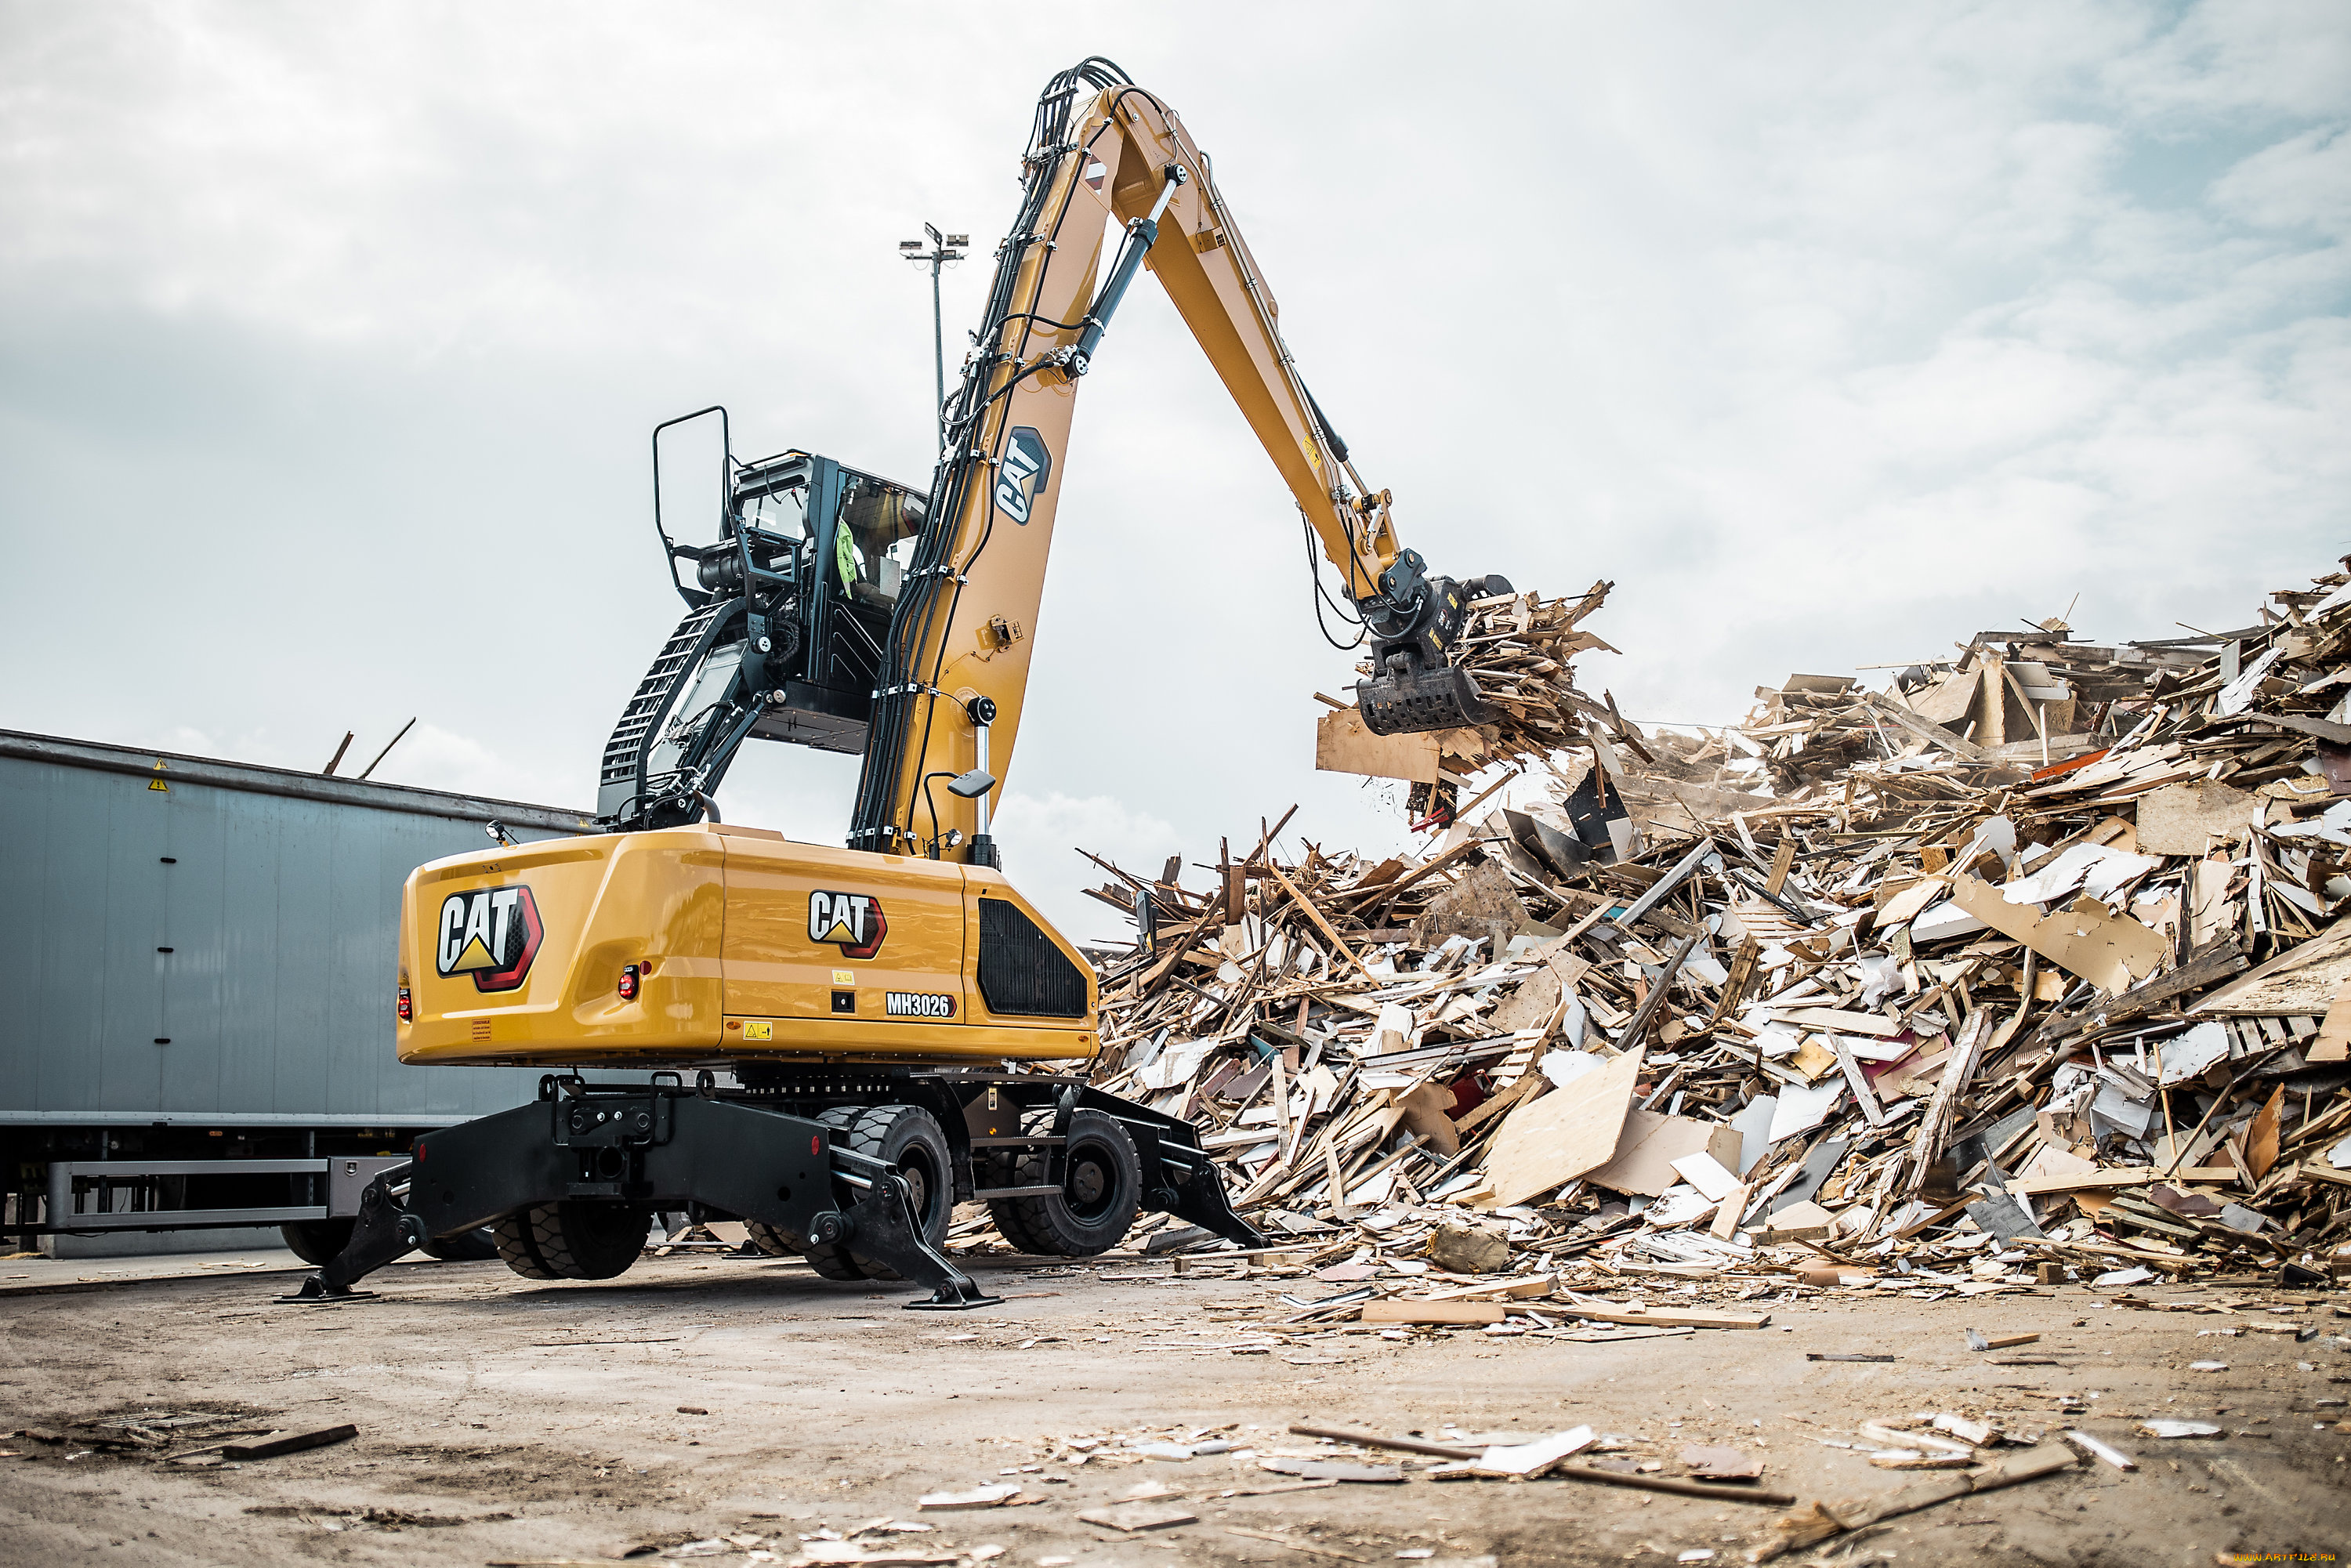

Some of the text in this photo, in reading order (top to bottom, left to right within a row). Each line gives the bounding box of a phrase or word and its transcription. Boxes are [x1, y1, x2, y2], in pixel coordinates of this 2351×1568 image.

[996, 436, 1040, 523] CAT
[439, 888, 519, 972] CAT
[810, 892, 869, 943] CAT
[886, 993, 949, 1016] MH3026
